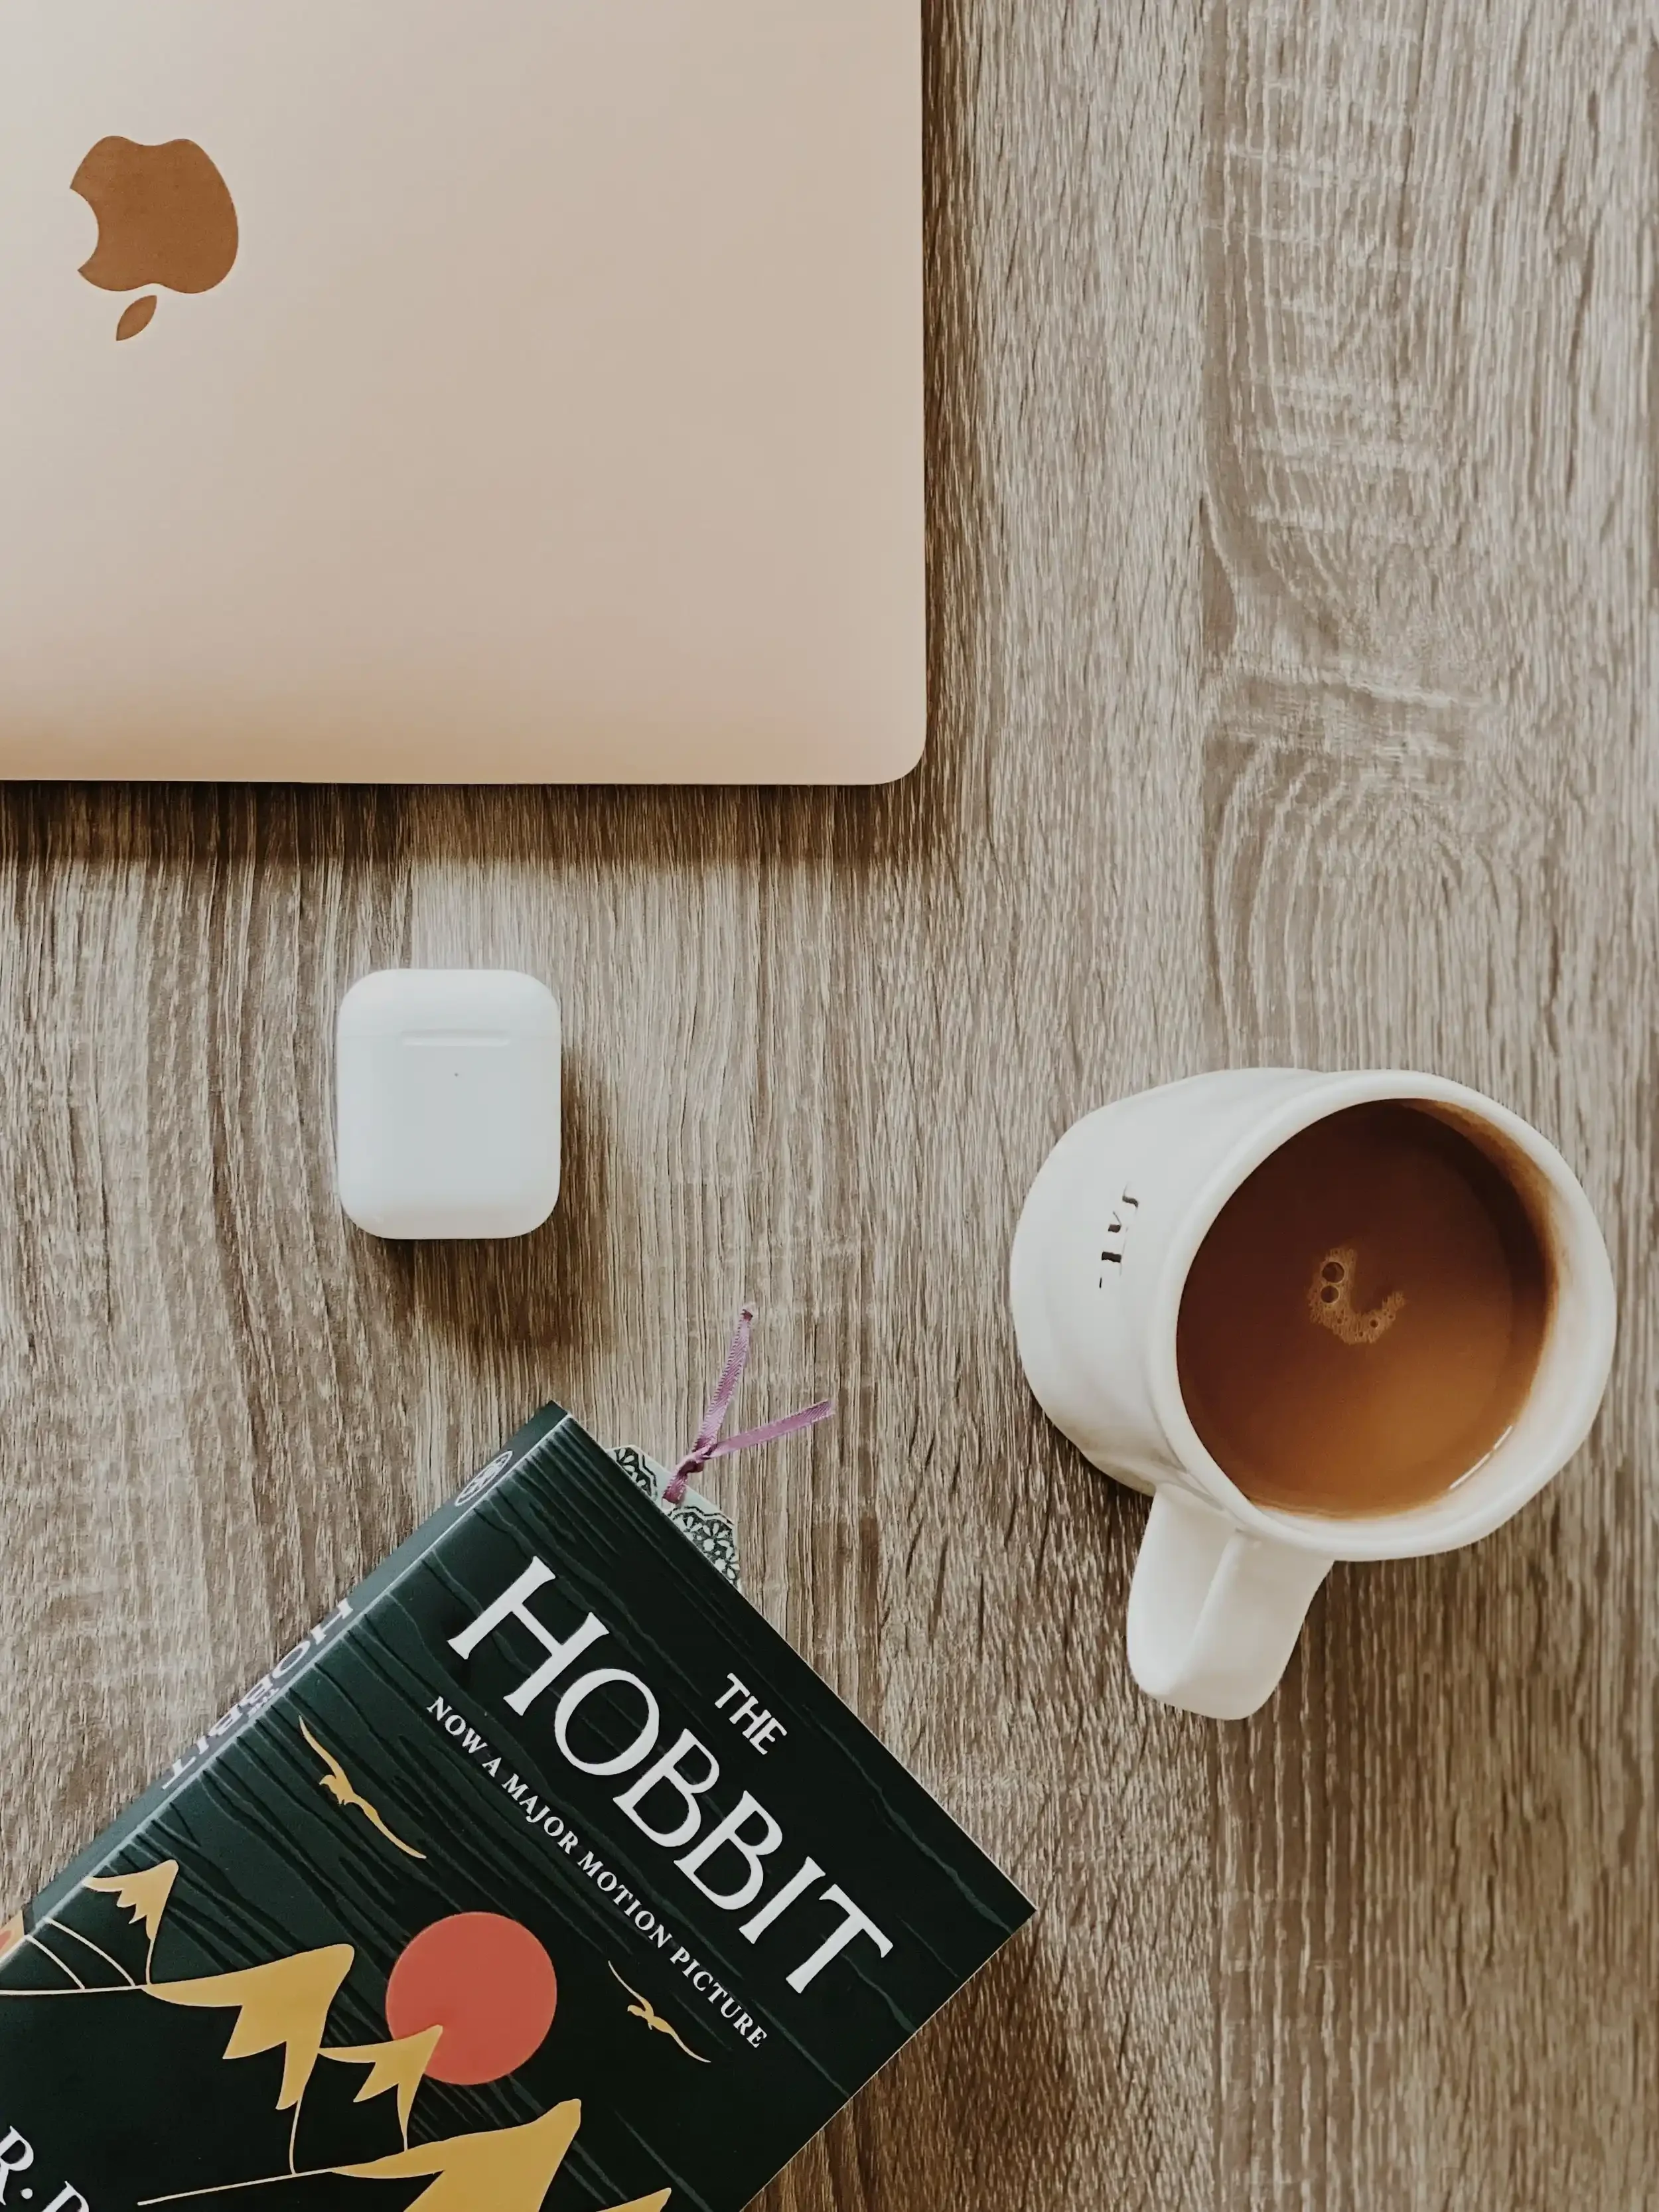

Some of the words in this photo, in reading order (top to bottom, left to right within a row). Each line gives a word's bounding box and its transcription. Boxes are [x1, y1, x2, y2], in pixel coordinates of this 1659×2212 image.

[162, 1597, 353, 1790] HOBBIT
[446, 1555, 894, 1994] HOBBIT
[713, 1672, 788, 1755] THE
[427, 1696, 488, 1753] NOW
[482, 1757, 502, 1777] A
[501, 1773, 579, 1854] MAJOR
[577, 1850, 673, 1949] MOTION
[670, 1946, 768, 2048] PICTURE
